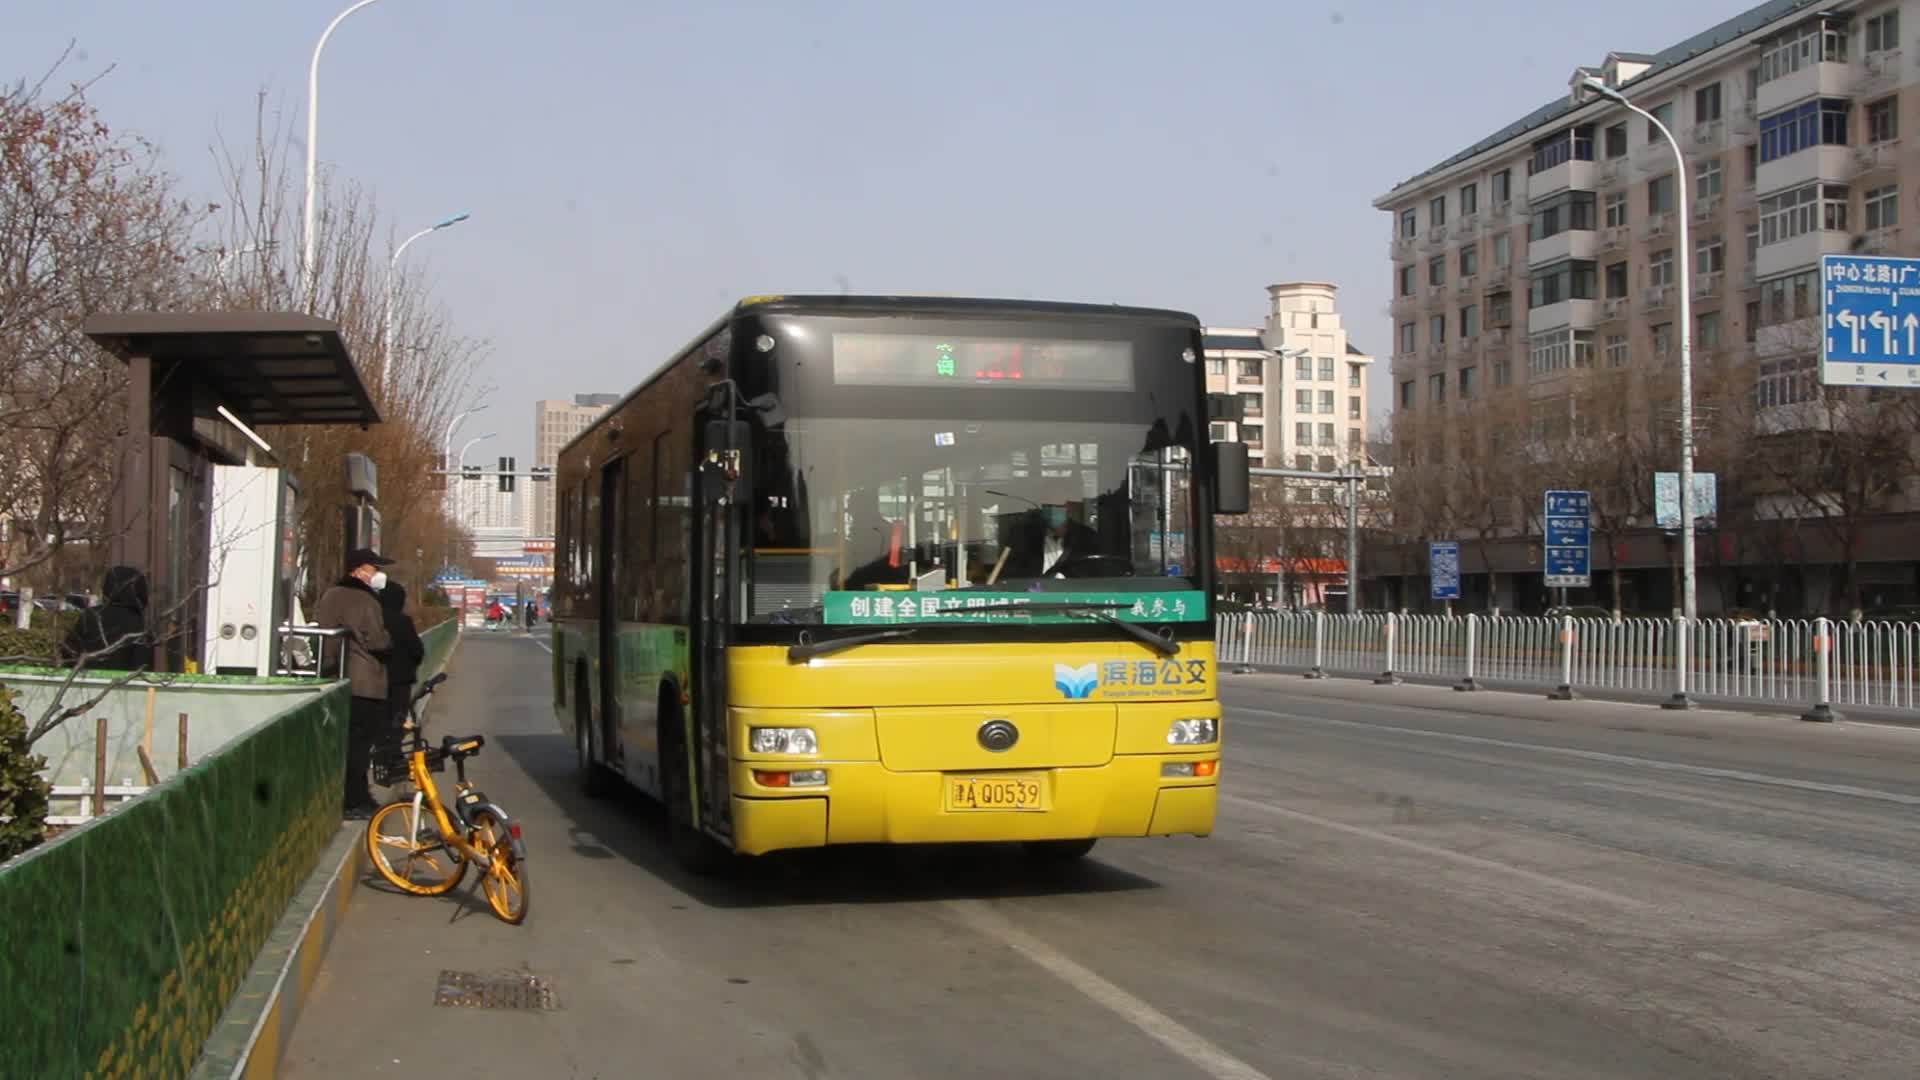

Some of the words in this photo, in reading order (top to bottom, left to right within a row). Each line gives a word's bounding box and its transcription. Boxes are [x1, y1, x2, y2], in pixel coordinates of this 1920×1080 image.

[1833, 262, 1891, 283] 中心北路
[1899, 264, 1920, 284] 广
[1102, 659, 1206, 686] 滨海公交
